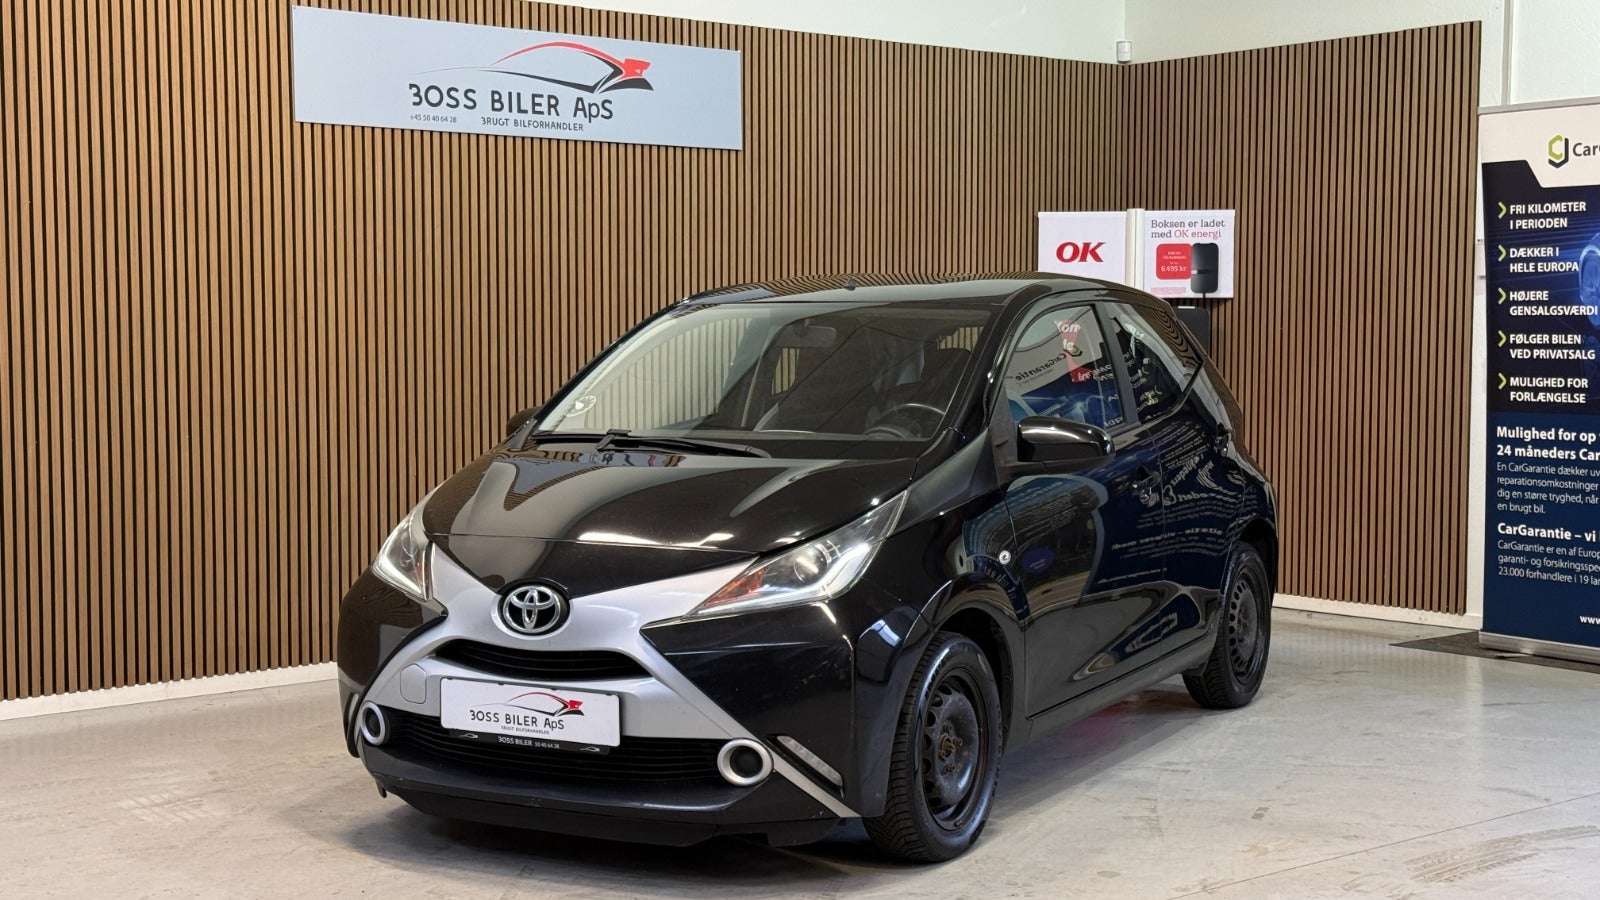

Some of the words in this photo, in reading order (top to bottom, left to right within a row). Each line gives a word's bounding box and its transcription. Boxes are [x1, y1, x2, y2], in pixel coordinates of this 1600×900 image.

[490, 91, 561, 117] BILER
[573, 96, 614, 124] ApS
[513, 119, 584, 132] BILFORHANDLER
[1572, 142, 1600, 157] Car
[1510, 204, 1526, 215] FRI
[1528, 202, 1586, 214] KILOMETER
[1151, 219, 1185, 229] Boksen
[1200, 219, 1225, 228] ladet
[1515, 218, 1568, 230] PERIODEN
[1151, 230, 1172, 239] med
[1174, 230, 1189, 239] OK
[1191, 229, 1222, 240] energi
[1056, 241, 1106, 263] OK
[1510, 247, 1553, 258] DÆKKER
[1510, 262, 1535, 273] HELE
[1538, 262, 1579, 272] EUROPA
[1510, 290, 1549, 301] HØJERE
[1510, 305, 1598, 316] GENSALGSVÆRDI
[1510, 334, 1549, 345] FØLGER
[1552, 334, 1581, 345] BILEN
[1510, 348, 1531, 359] VED
[1533, 349, 1596, 360] PRIVATSALG
[1510, 378, 1565, 389] MULIGHED
[1567, 378, 1588, 389] FOR
[1510, 391, 1586, 404] FORLÆNGELSE
[1497, 426, 1555, 442] Mulighed
[1558, 428, 1577, 441] for
[1579, 432, 1596, 445] op
[1497, 445, 1511, 456] 24
[1514, 444, 1577, 460] måneders
[1497, 462, 1507, 471] En
[1508, 463, 1556, 474] CarGarantie
[1558, 465, 1588, 476] dækker
[1497, 476, 1599, 492] reparationsomkostninger
[1497, 489, 1510, 499] dig
[1512, 491, 1522, 499] en
[1525, 491, 1548, 500] større
[1549, 493, 1583, 504] tryghed,
[1585, 494, 1599, 505] når
[1509, 503, 1532, 514] brugt
[1533, 504, 1546, 514] bil.
[1497, 523, 1572, 540] CarGarantie
[1584, 531, 1596, 542] vi
[1497, 540, 1545, 553] CarGarantie
[1546, 546, 1555, 554] er
[1556, 547, 1567, 555] en
[1568, 547, 1577, 556] af
[1498, 555, 1529, 566] garanti-
[1530, 557, 1542, 567] og
[1498, 567, 1525, 578] 23.000
[1526, 569, 1572, 583] forhandlere
[1579, 575, 1589, 584] 19
[505, 713, 538, 727] BILER
[543, 717, 565, 731] ApS
